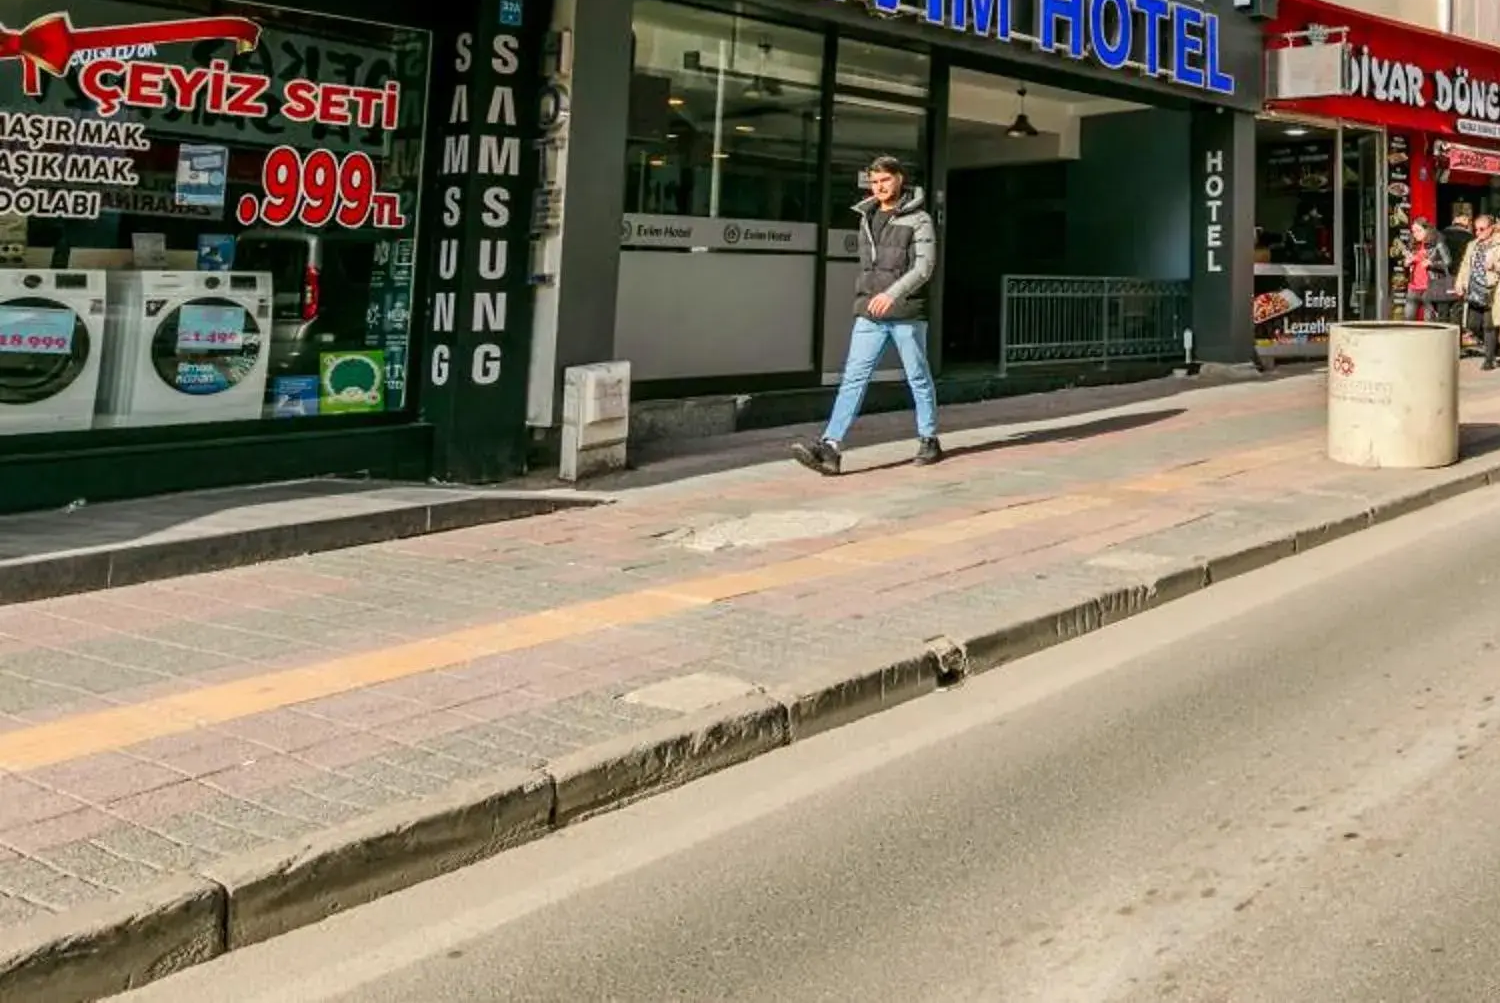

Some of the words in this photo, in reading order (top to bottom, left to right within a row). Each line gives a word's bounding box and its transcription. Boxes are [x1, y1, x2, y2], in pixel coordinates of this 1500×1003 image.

[79, 58, 270, 117] ÇEYİZ
[280, 79, 401, 130] SETİ
[65, 154, 139, 185] MAK.
[75, 119, 151, 150] MAK.
[431, 31, 473, 386] SAMSUNG
[471, 33, 521, 385] SAMSUNG
[1205, 150, 1224, 272] HOTEL
[1304, 290, 1337, 309] Enfes
